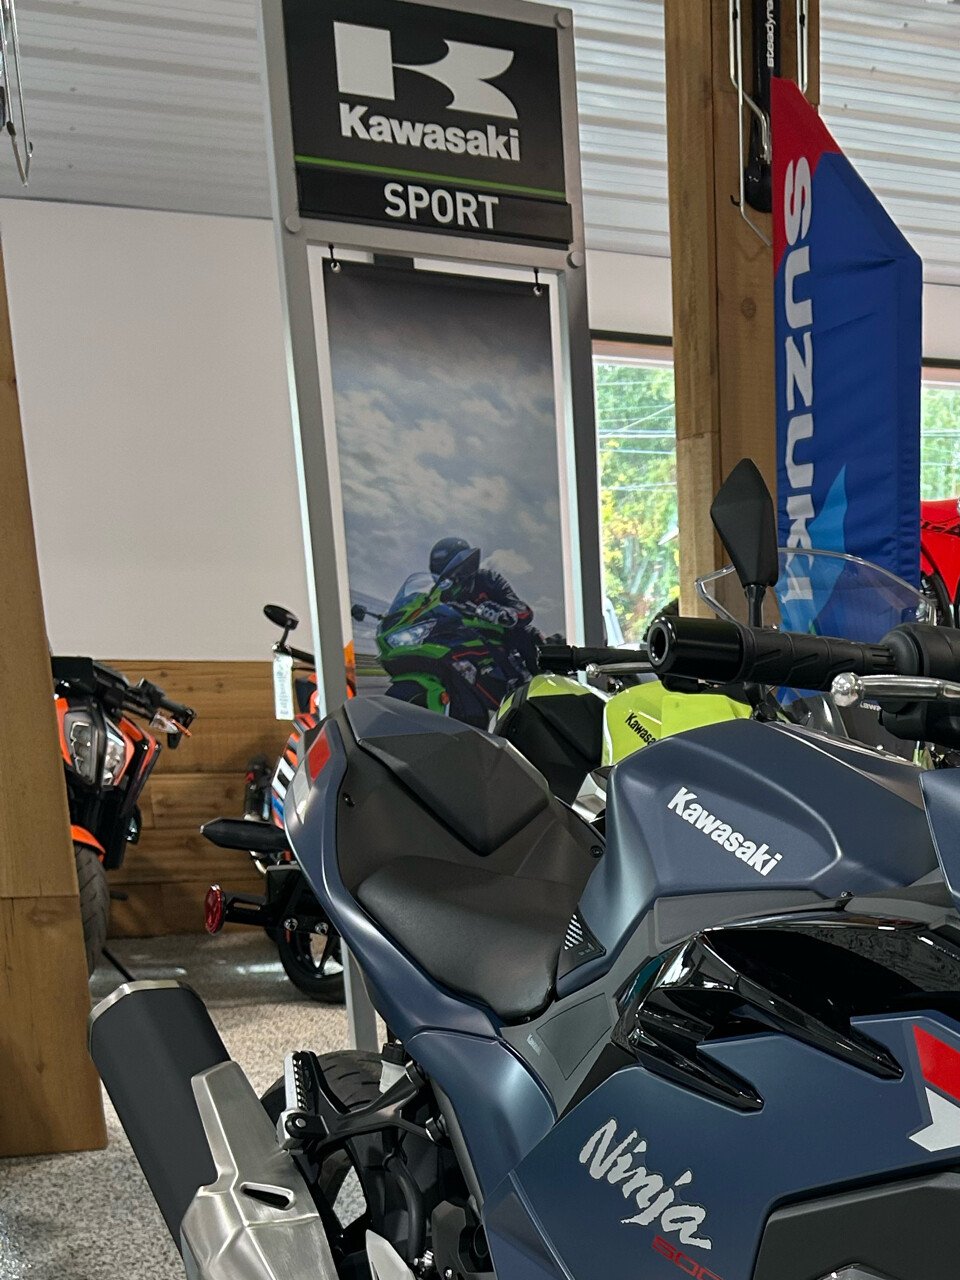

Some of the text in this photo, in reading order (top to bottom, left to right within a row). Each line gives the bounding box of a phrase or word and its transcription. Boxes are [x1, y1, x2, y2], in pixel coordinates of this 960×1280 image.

[764, 0, 777, 68] steadyra
[339, 102, 521, 161] Kawasaki
[383, 182, 499, 229] SPORT
[780, 155, 815, 604] SUZUKI
[624, 712, 657, 746] Kawasa
[667, 786, 783, 876] Kawasaki
[579, 1119, 712, 1250] Ninja
